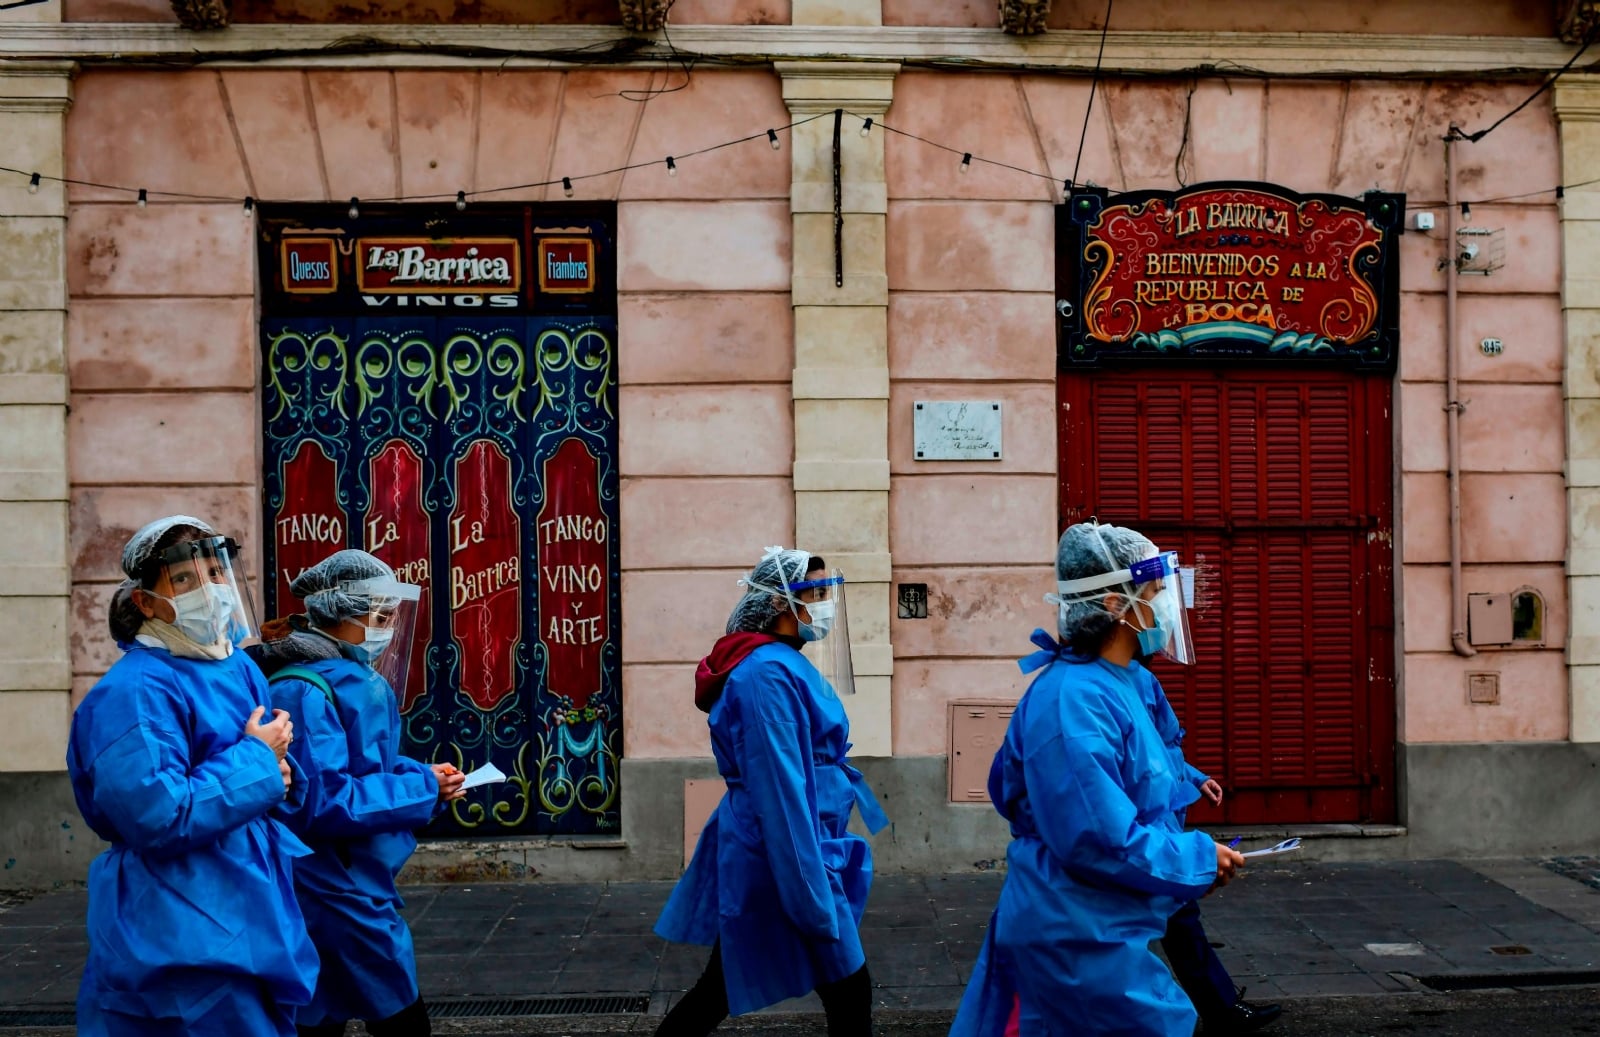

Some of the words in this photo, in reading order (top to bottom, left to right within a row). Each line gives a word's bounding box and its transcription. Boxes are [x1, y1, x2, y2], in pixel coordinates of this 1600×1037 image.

[1175, 210, 1201, 237] LA
[1206, 202, 1290, 237] BARRICA
[291, 251, 330, 281] Quesos
[366, 246, 400, 270] La
[390, 246, 511, 283] Barrica
[547, 251, 588, 280] Fiambres
[1146, 253, 1280, 277] BIENVENIDOS
[1290, 262, 1302, 277] A
[1306, 262, 1327, 279] LA
[362, 295, 519, 307] VINOS
[1134, 280, 1269, 306] REPUBLICA
[1282, 287, 1304, 302] DE
[1163, 313, 1181, 328] LA
[1185, 302, 1277, 330] BOCA
[1484, 341, 1501, 353] 845
[278, 513, 343, 545] TANGO
[367, 514, 401, 554] La
[451, 514, 486, 555] La
[541, 514, 606, 544] TANGO
[451, 556, 521, 610] Barrica
[543, 564, 602, 593] VINO
[571, 601, 583, 615] Y
[547, 616, 603, 645] ARTE
